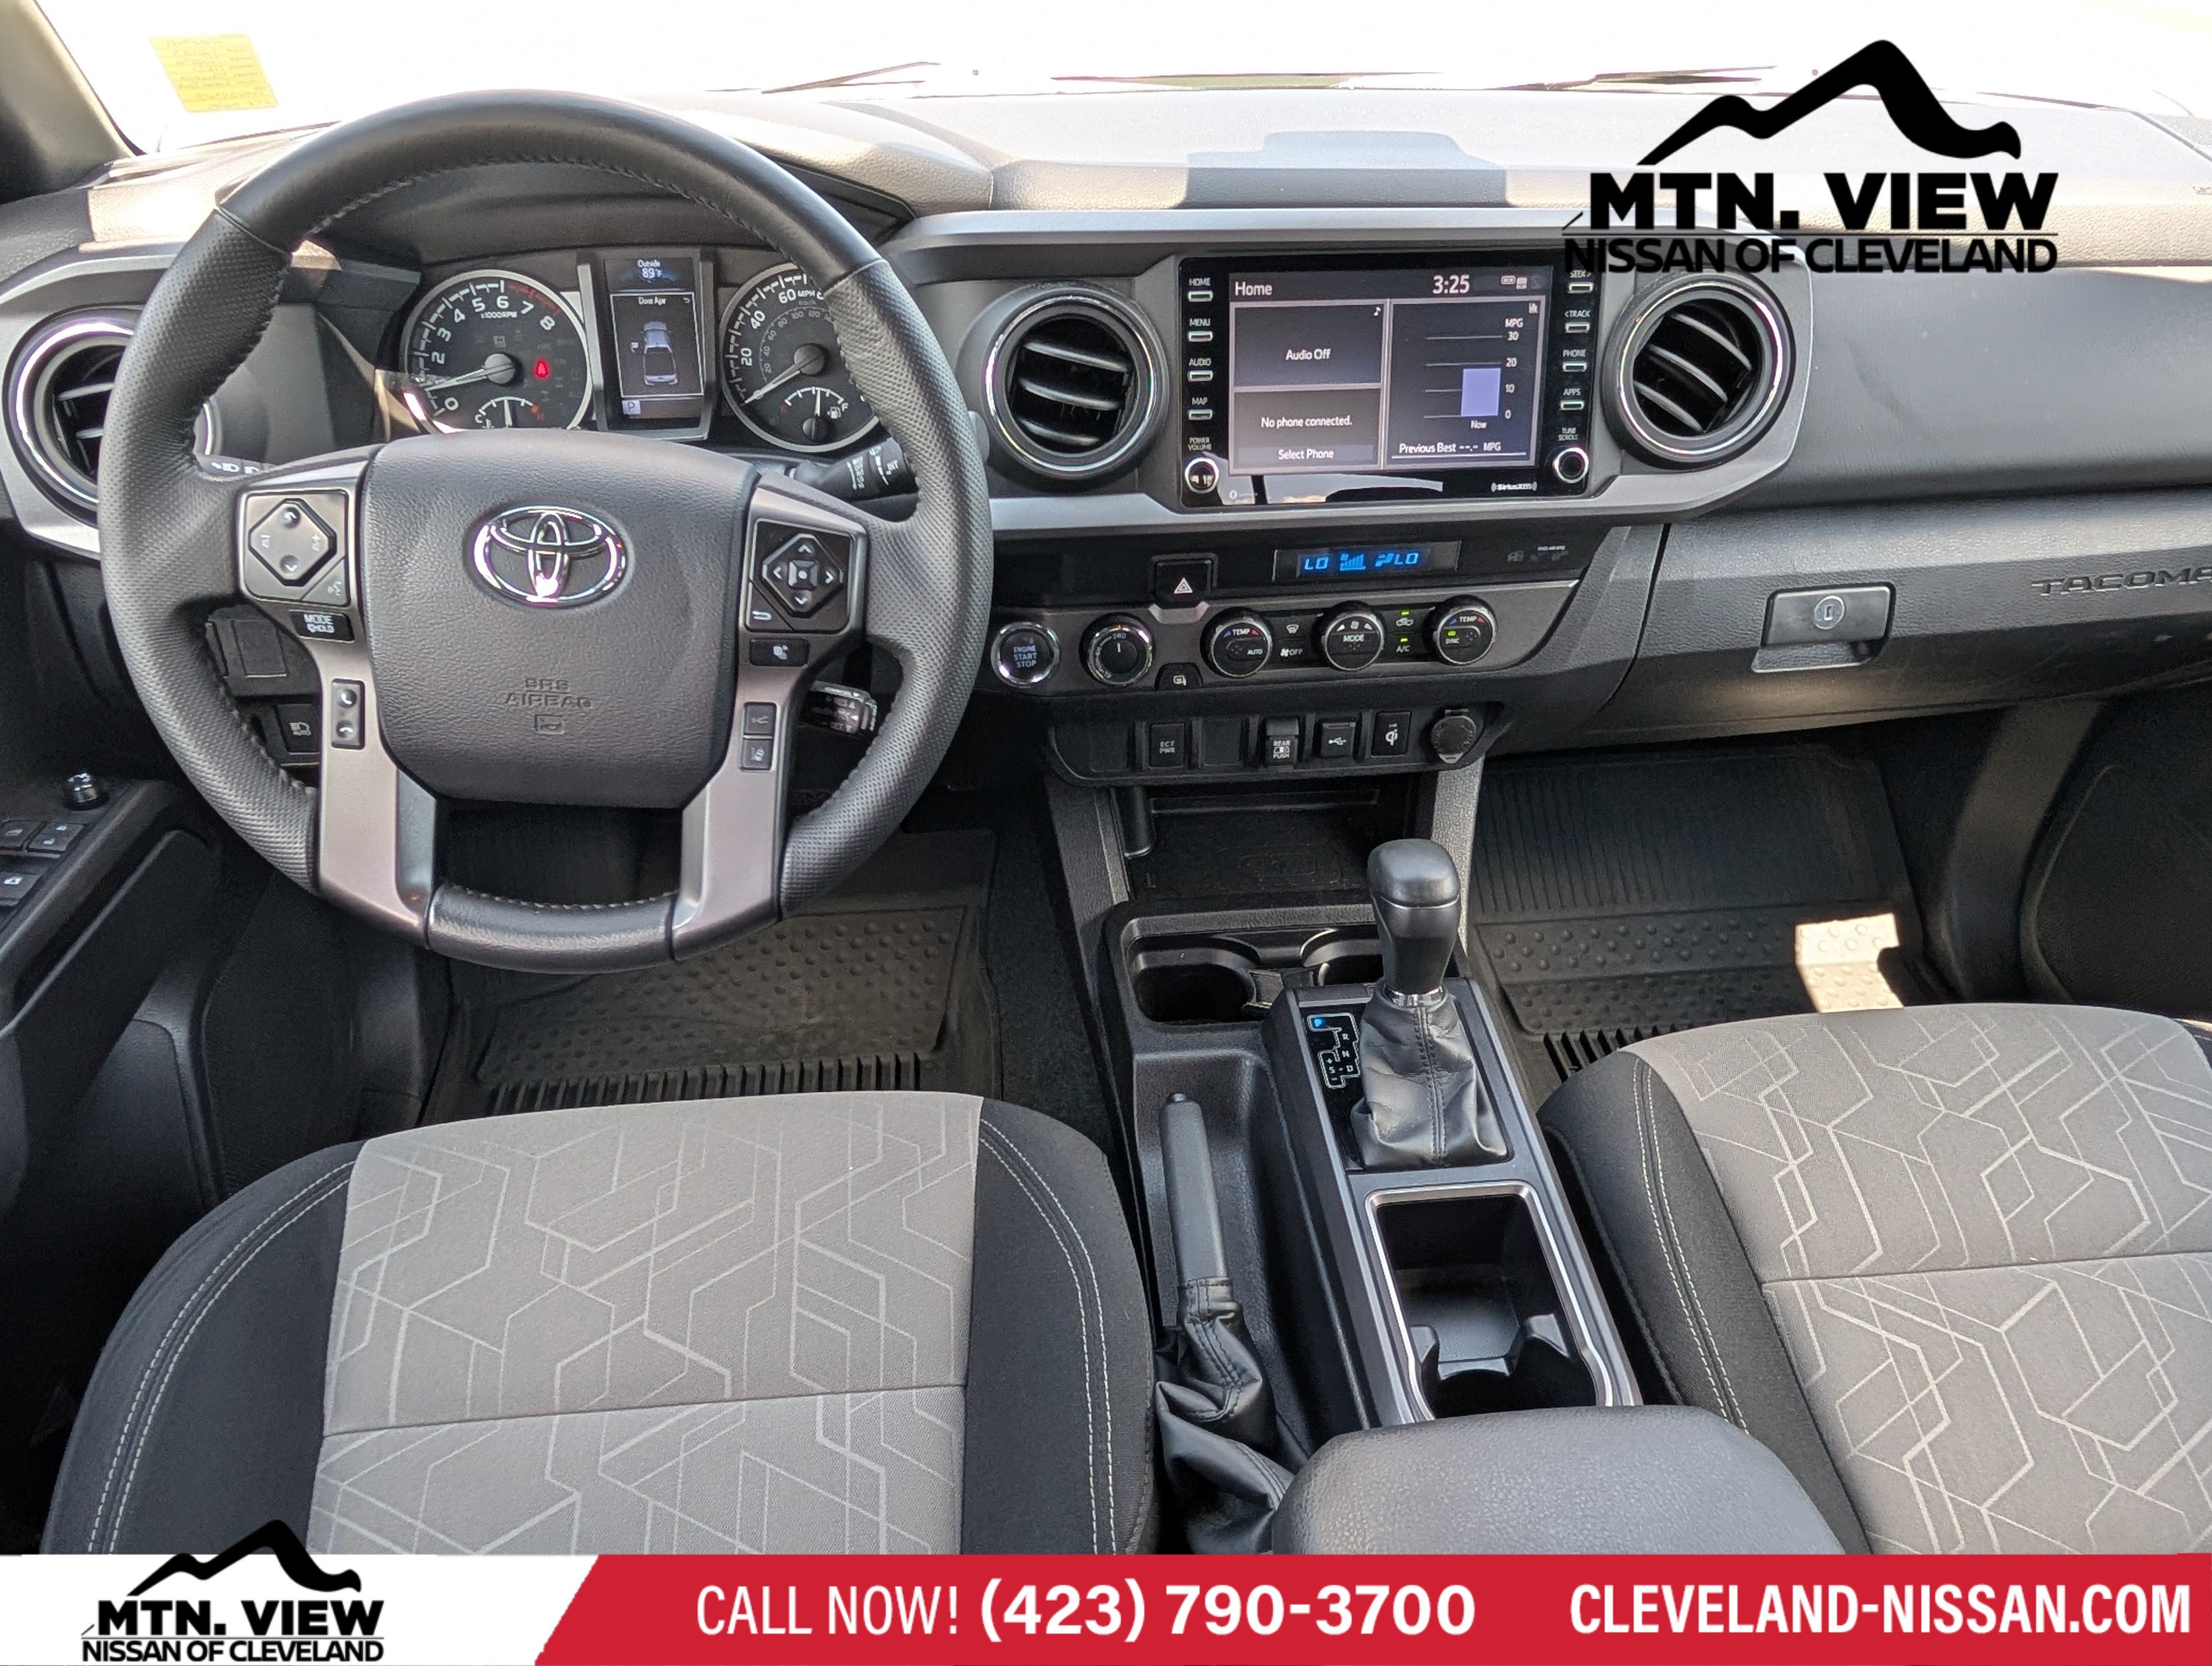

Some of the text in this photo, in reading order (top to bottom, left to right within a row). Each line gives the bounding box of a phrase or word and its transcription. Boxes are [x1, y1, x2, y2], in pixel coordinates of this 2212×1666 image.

[1189, 277, 1211, 286] HOME
[1432, 275, 1470, 294] 3:25
[1234, 281, 1272, 296] Home
[496, 296, 509, 309] 6
[779, 289, 796, 304] 60
[472, 297, 485, 312] 5
[520, 300, 535, 315] 7
[454, 308, 466, 323] 4
[750, 310, 766, 329] 40
[539, 316, 556, 330] 8
[1505, 318, 1523, 328] MPG
[437, 328, 451, 342] 3
[1507, 331, 1519, 341] 30
[431, 352, 445, 364] 2
[740, 348, 753, 366] 20
[1285, 348, 1331, 361] Audio Off
[1562, 349, 1586, 357] PHONE
[1189, 358, 1212, 366] AUDIO
[1506, 357, 1517, 368] 20
[1505, 383, 1515, 393] 10
[444, 397, 459, 411] 0
[627, 402, 635, 412] P
[1505, 409, 1512, 419] 0
[1261, 414, 1352, 430] No phone connected.
[1470, 420, 1487, 429] Now
[1399, 443, 1435, 454] Previous
[1437, 443, 1456, 453] Best
[1483, 441, 1501, 452] MPG
[1278, 448, 1334, 460] Select Phone
[1304, 557, 1329, 570] LO
[304, 614, 333, 625] MODE
[1343, 634, 1365, 643] MODE
[1013, 652, 1038, 661] START
[1017, 659, 1037, 668] STOP
